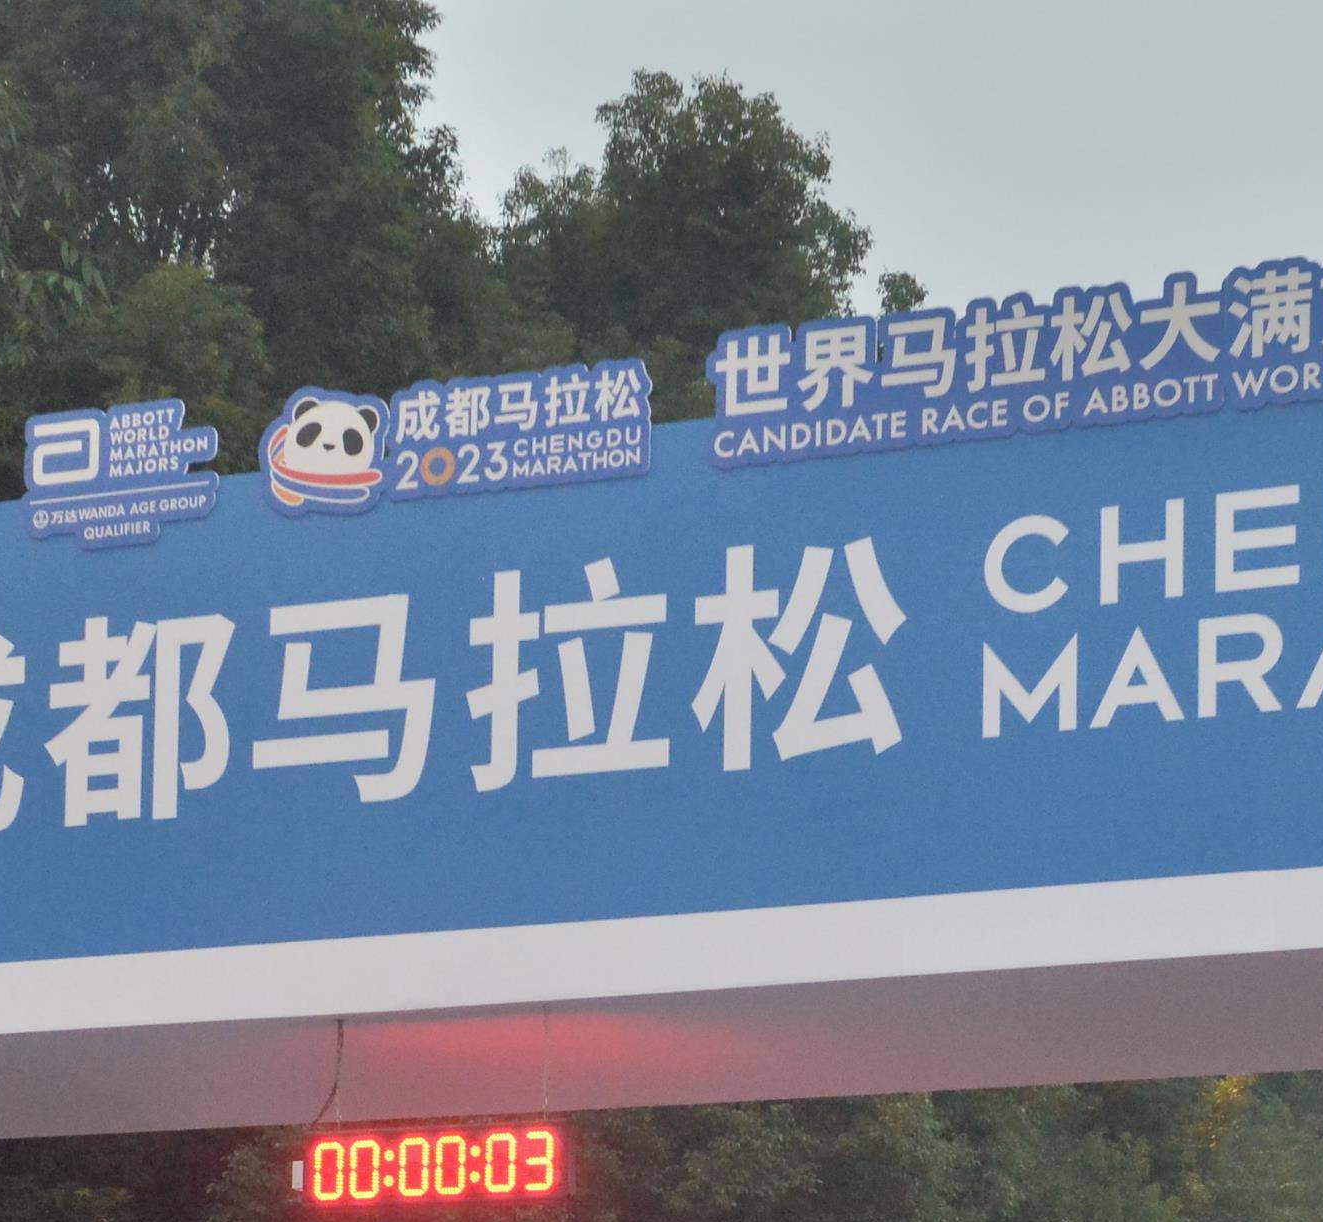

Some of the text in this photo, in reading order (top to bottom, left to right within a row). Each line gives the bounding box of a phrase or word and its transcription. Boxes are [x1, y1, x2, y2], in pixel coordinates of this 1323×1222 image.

[395, 368, 641, 443] 成都马拉松
[713, 410, 907, 459] CANDIDATE
[922, 400, 1008, 436] RACE
[1023, 392, 1069, 423] OF
[1083, 373, 1220, 416] ABBOTT
[109, 409, 175, 431] ABBOTT
[110, 426, 169, 444] WORLD
[514, 428, 641, 456] CHENGDU
[109, 437, 208, 461] MARATHON
[109, 457, 179, 478] MAJORS
[395, 442, 509, 491] 2023
[514, 449, 641, 478] MARATHON
[79, 504, 125, 521] WANDA
[130, 501, 157, 514] AGE
[159, 496, 207, 512] GROUP
[84, 521, 151, 540] QUALIFIER
[313, 1131, 555, 1201] 00:00:03
